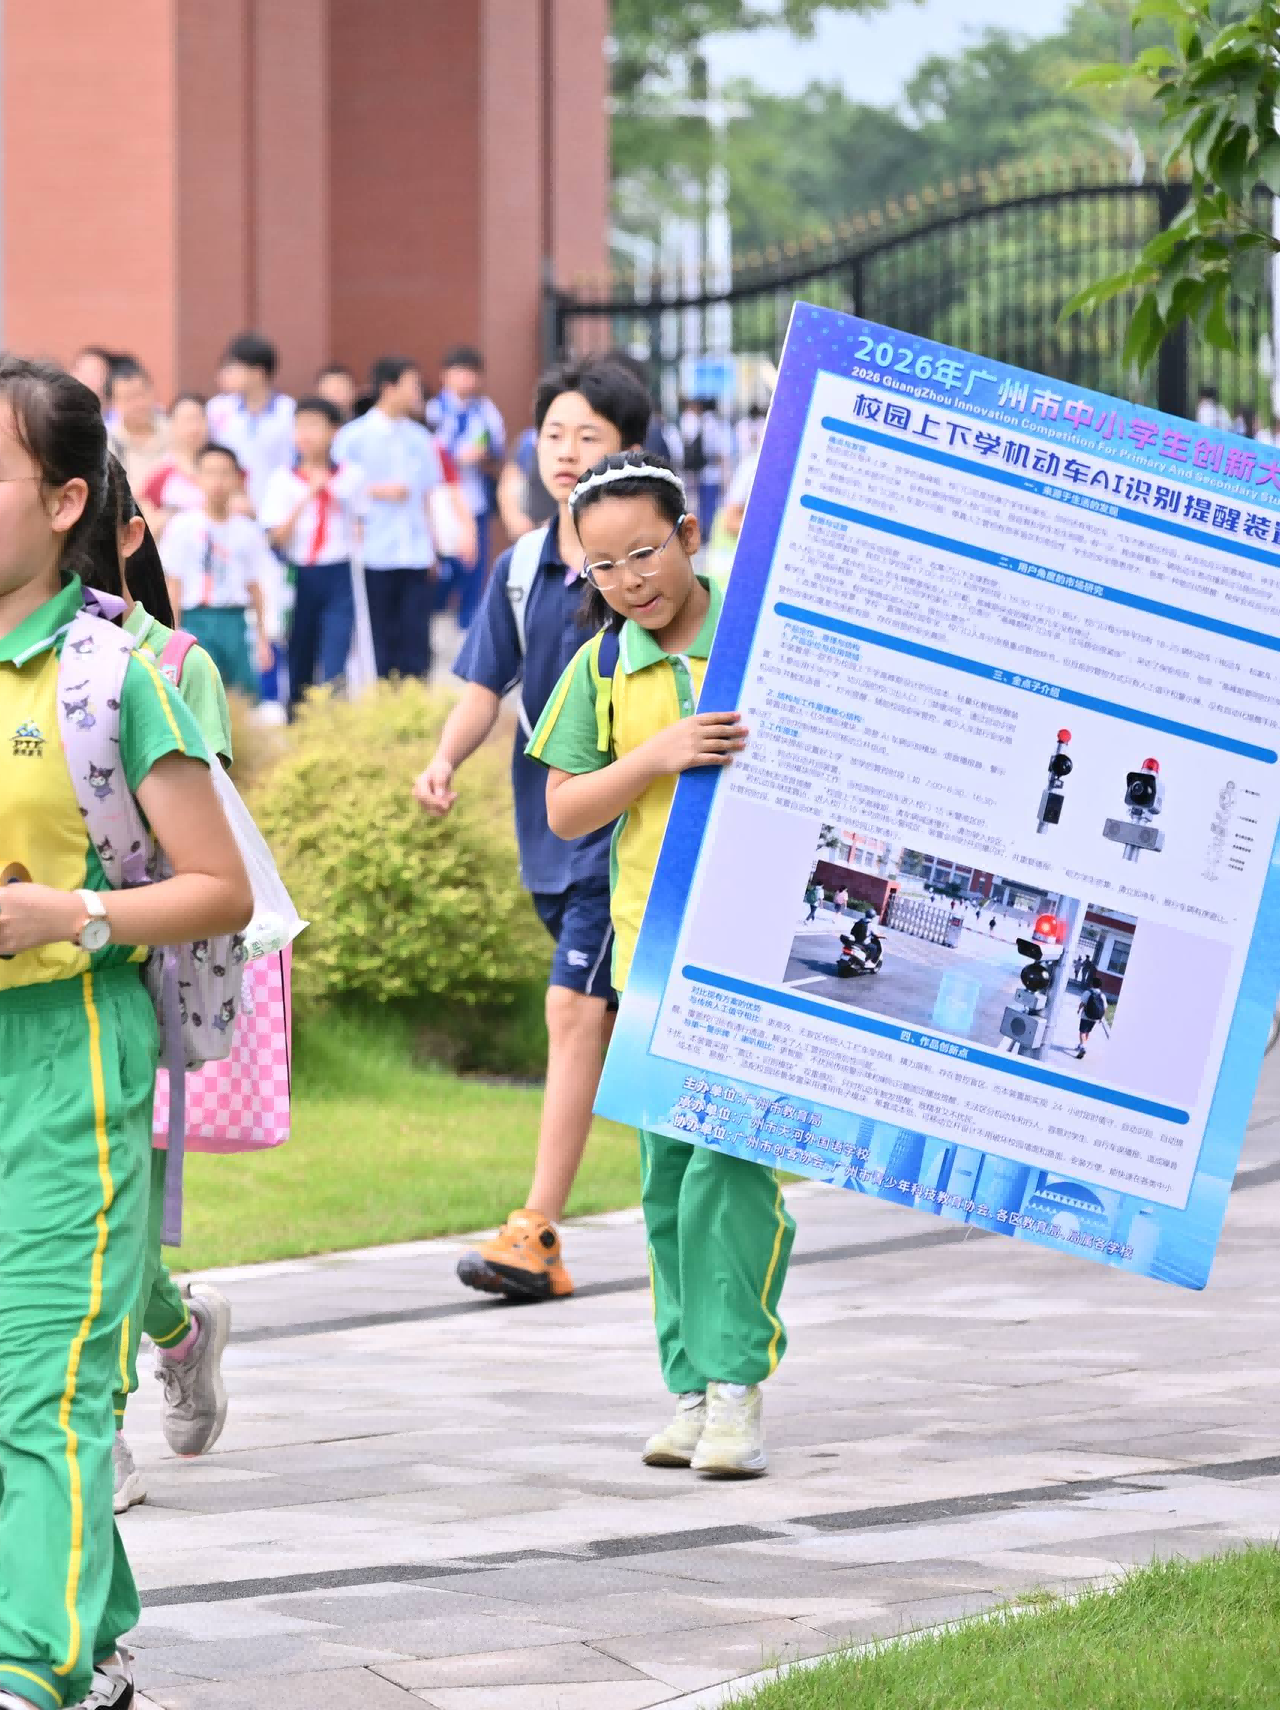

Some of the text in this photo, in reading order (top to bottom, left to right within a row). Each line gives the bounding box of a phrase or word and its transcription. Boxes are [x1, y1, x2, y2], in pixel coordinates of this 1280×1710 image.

[851, 366, 880, 383] 2026
[882, 375, 952, 406] GuangZhou
[954, 397, 1019, 426] Innovation
[1021, 418, 1095, 449] Competition
[1097, 442, 1117, 457] For
[1120, 449, 1166, 472] Primary
[1168, 464, 1193, 480] And
[1195, 472, 1258, 500] Secondary
[991, 668, 1061, 698] 三、金点子介绍
[899, 1029, 969, 1059] 四、作品创新点
